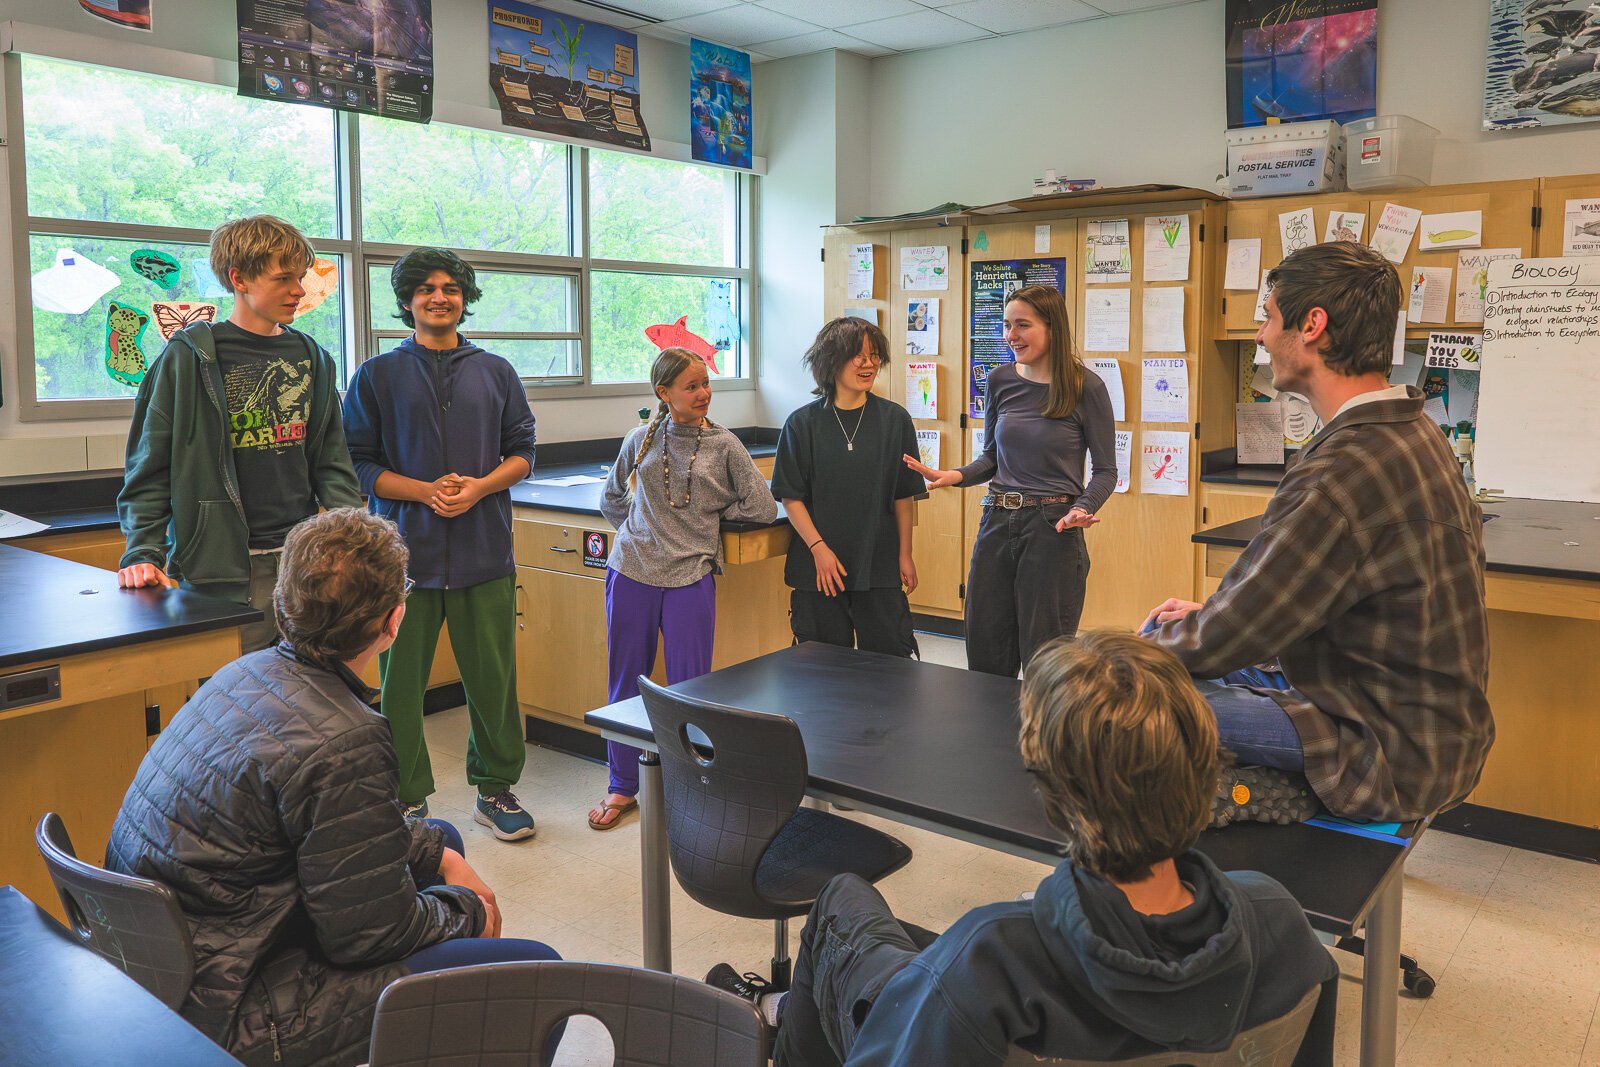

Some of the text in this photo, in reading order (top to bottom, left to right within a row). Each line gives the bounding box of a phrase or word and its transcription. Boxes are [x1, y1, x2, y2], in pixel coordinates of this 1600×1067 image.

[494, 11, 540, 27] PHOSPHORUS
[1237, 158, 1317, 173] POSTAL SERVICE
[911, 246, 936, 256] WANTED
[982, 263, 1012, 272] We Salute
[1095, 260, 1121, 268] WANTED
[975, 271, 1018, 281] Henrietta
[1511, 263, 1581, 286] BIOLOGY
[977, 280, 1003, 290] Lacks
[1501, 290, 1548, 302] Introduction
[1551, 289, 1562, 298] to
[1566, 288, 1599, 305] Ecology
[1497, 304, 1522, 317] Creating
[1575, 304, 1586, 313] to
[1505, 315, 1599, 331] ecological relationships
[1430, 334, 1475, 346] THANK
[1497, 330, 1542, 340] Introduction
[1545, 328, 1556, 337] to
[1430, 346, 1457, 357] YOU
[1143, 359, 1185, 368] WANTED
[1428, 356, 1459, 368] BEES
[230, 422, 307, 449] ARLE
[917, 431, 938, 440] ANTED
[1115, 433, 1128, 441] NG
